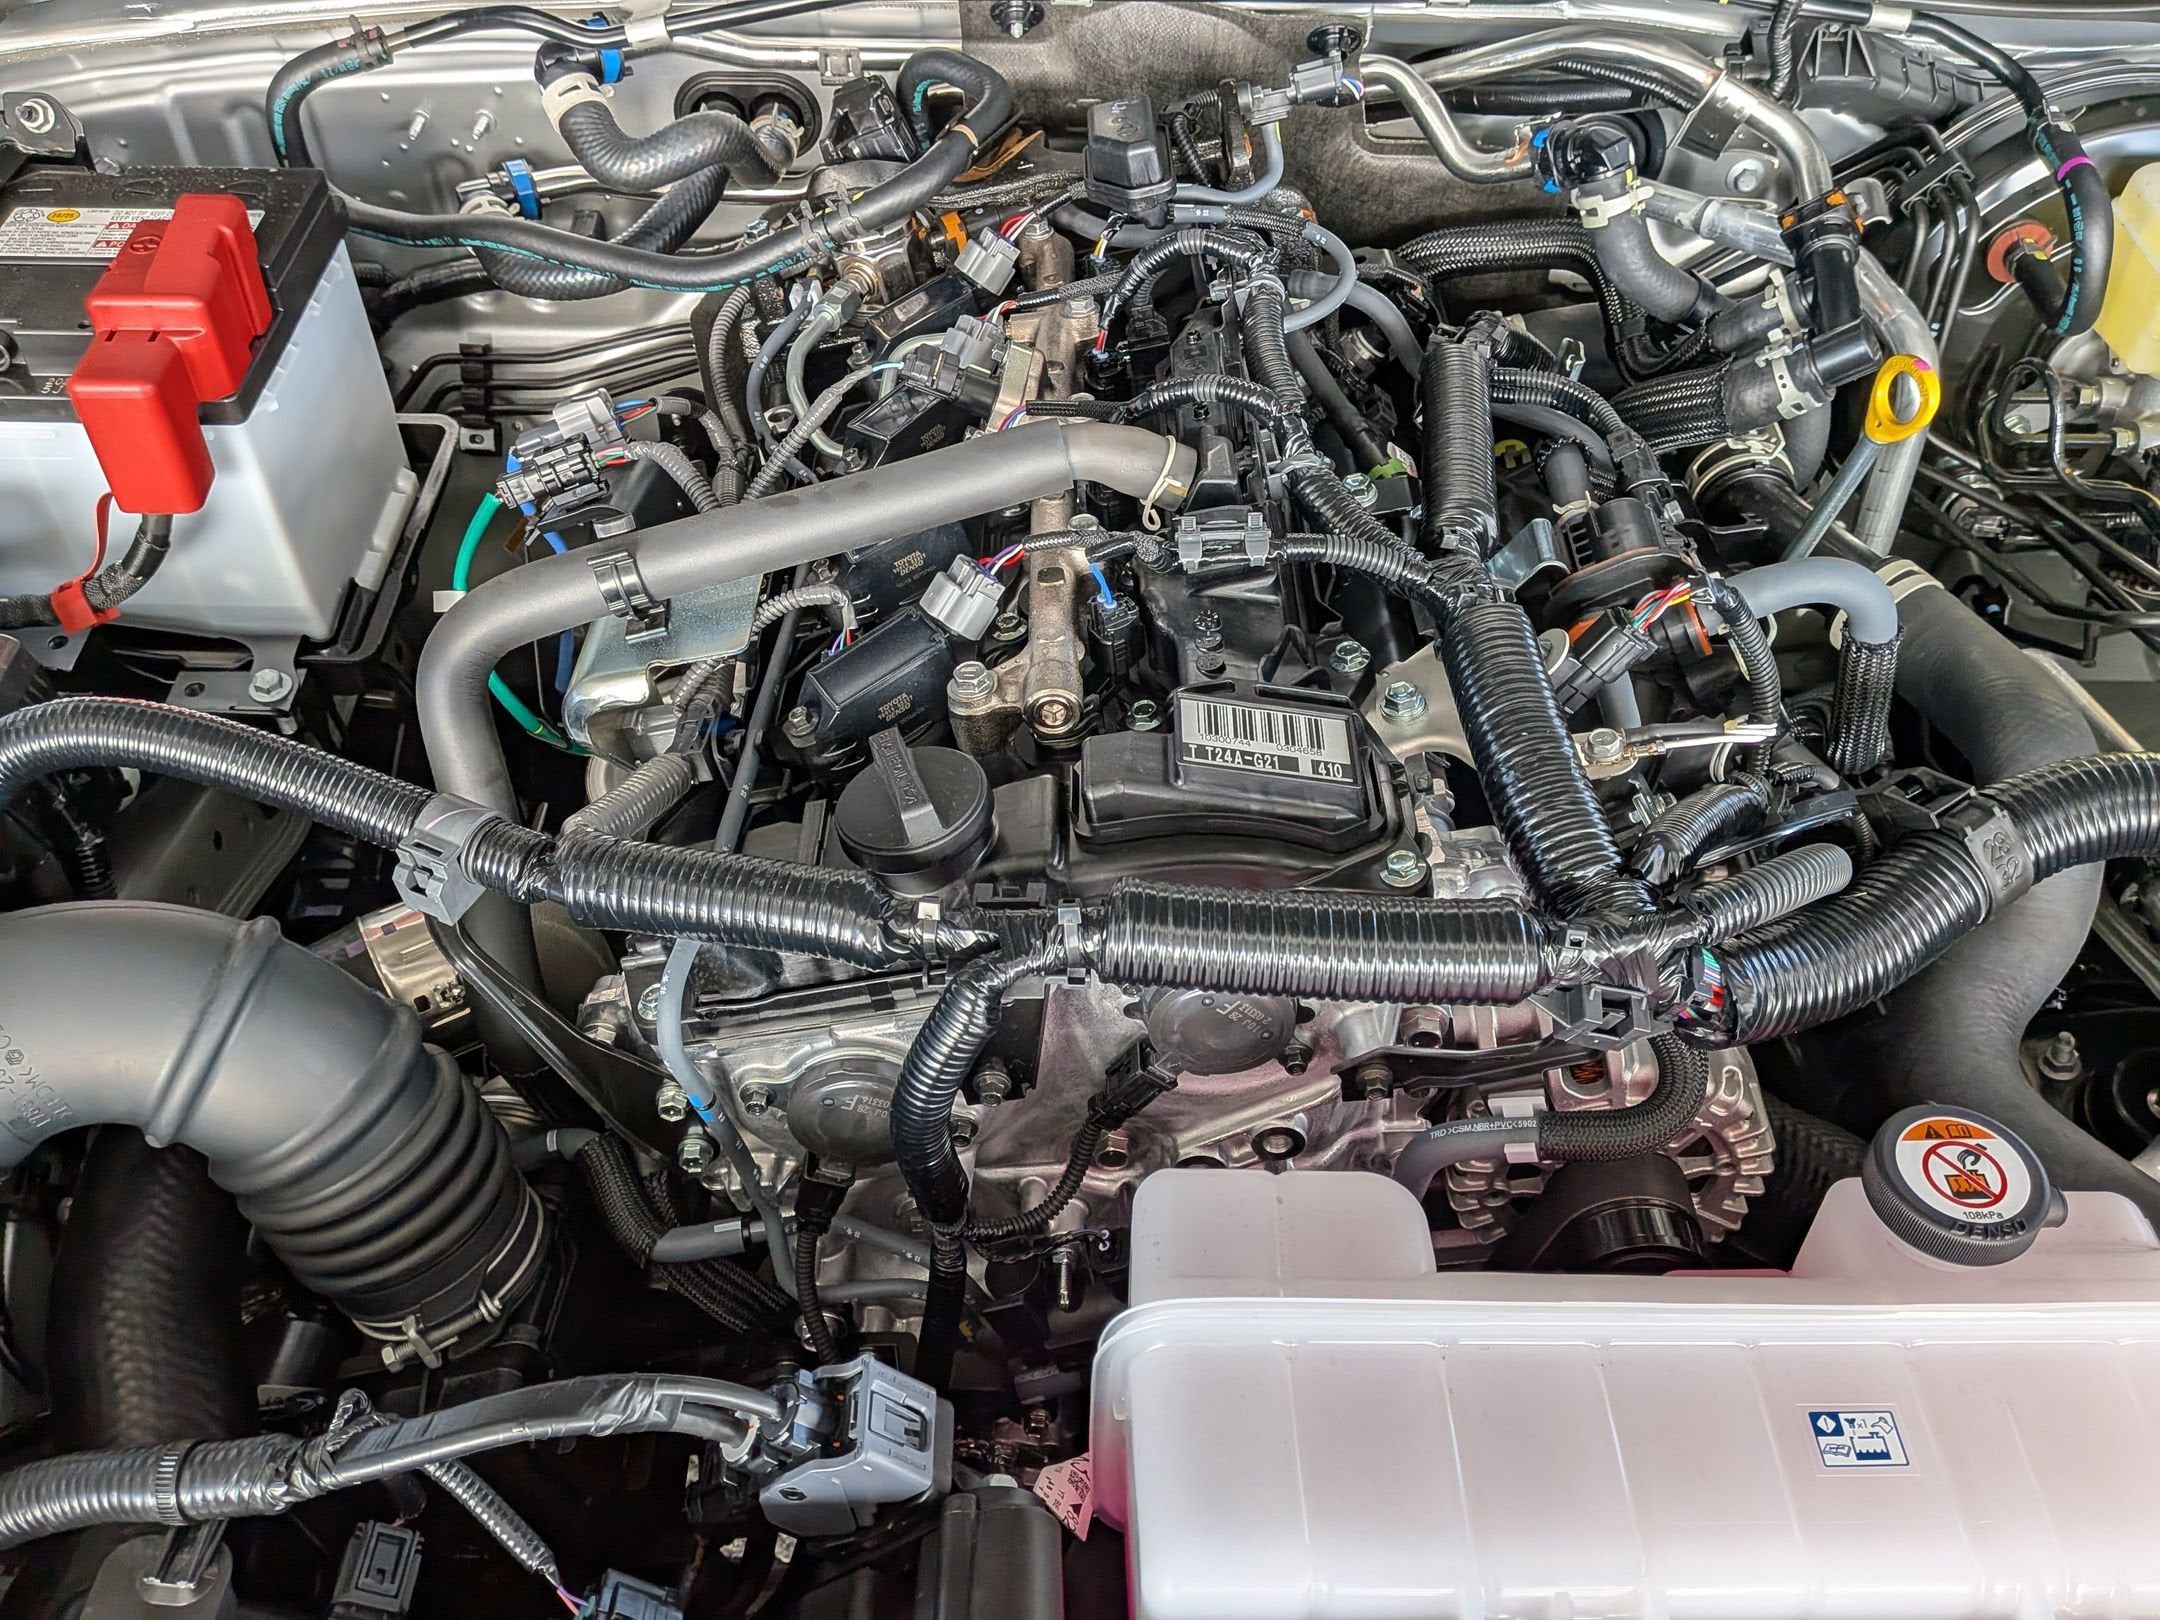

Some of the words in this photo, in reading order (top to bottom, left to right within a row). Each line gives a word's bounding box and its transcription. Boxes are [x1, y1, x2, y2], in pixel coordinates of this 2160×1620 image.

[893, 550, 922, 568] TOYOTA
[900, 560, 924, 576] DENSO
[878, 692, 909, 713] TOYOTA
[885, 702, 911, 722] DENSO
[1199, 733, 1251, 748] 10300744
[1188, 744, 1198, 760] T
[1205, 746, 1280, 770] T24A-G21
[1317, 762, 1343, 778] 410
[1215, 1000, 1241, 1015] F
[1238, 1003, 1265, 1021] 03313
[1963, 1210, 2004, 1221] 108kPa
[1950, 1217, 2028, 1241] DENSO
